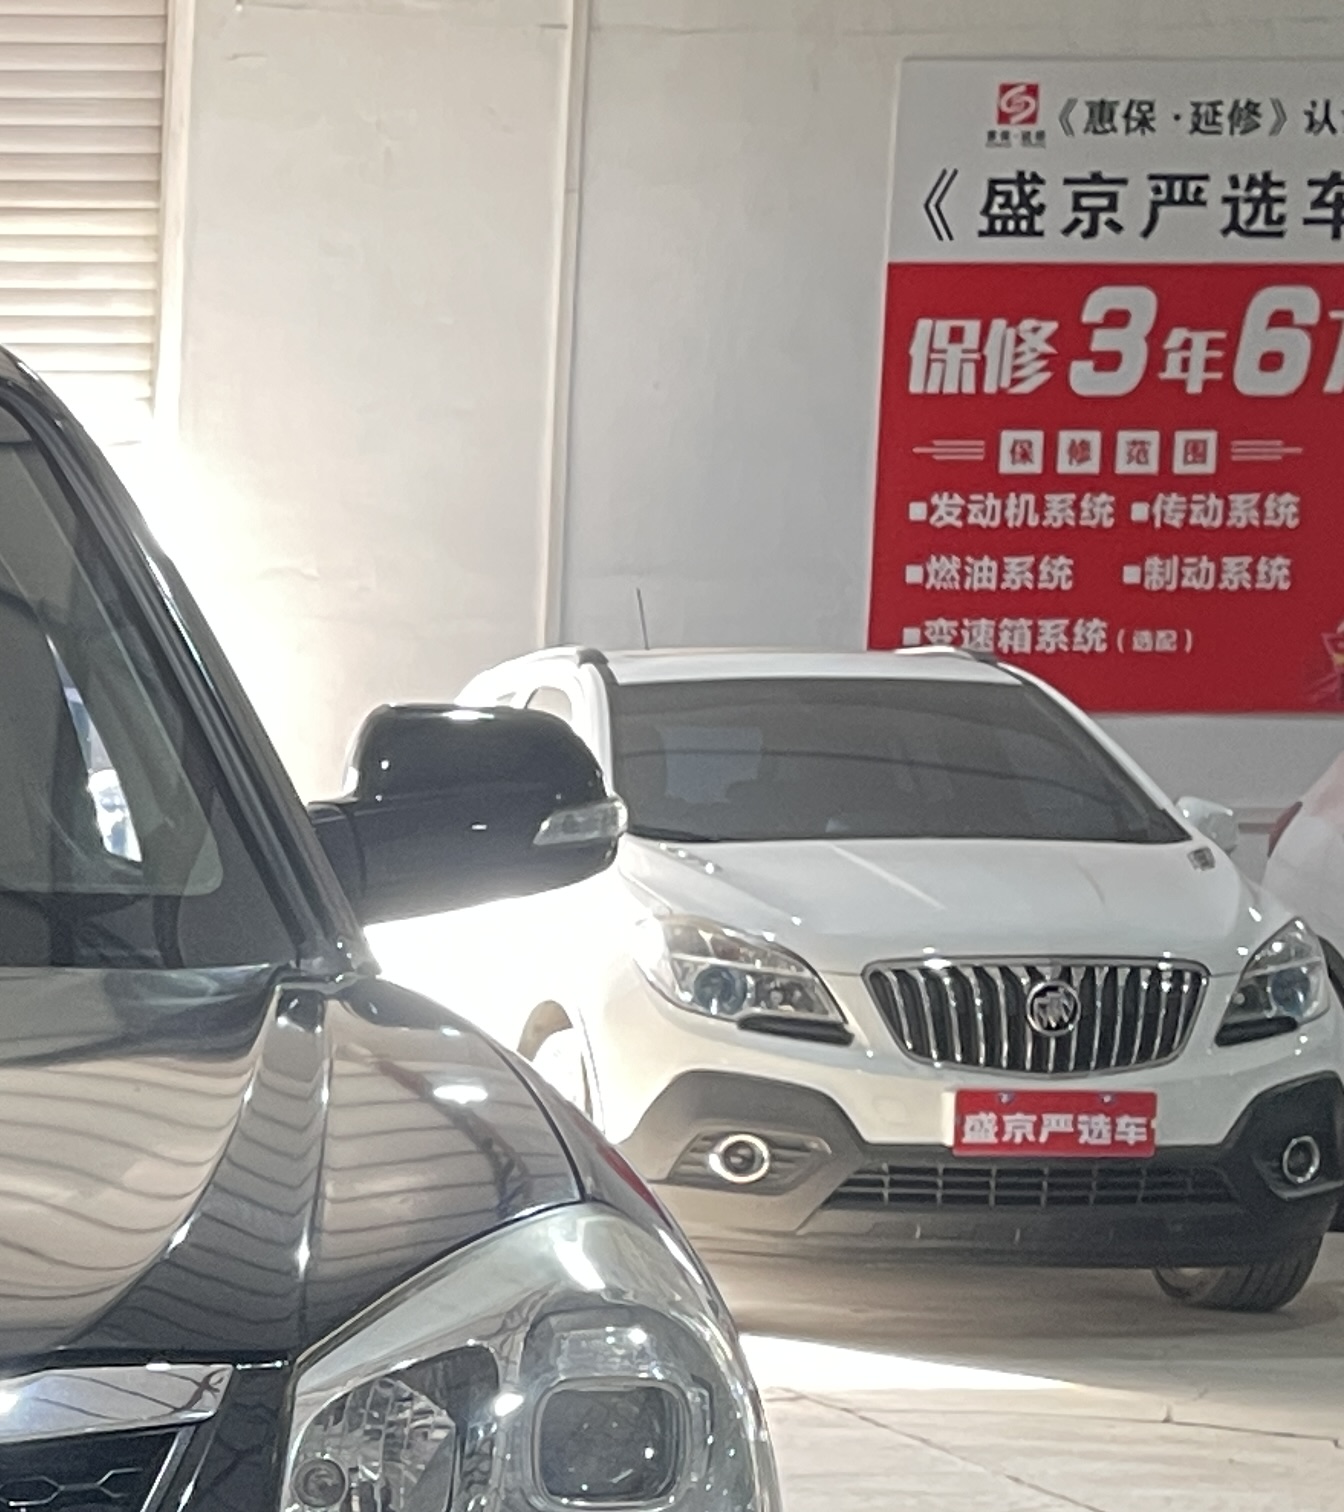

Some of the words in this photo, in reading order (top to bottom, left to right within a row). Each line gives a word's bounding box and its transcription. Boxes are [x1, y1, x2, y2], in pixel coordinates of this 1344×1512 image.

[1058, 98, 1344, 137] 《惠保·延修》认
[923, 168, 1344, 241] 《盛京严选车
[928, 492, 1115, 529] 发动机系统
[1151, 492, 1301, 529] 传动系统
[924, 554, 1074, 592] 燃油系统
[1144, 554, 1292, 592] 制动系统
[923, 617, 1109, 655] 变速箱系统
[961, 1112, 1148, 1145] 盛京严选车
